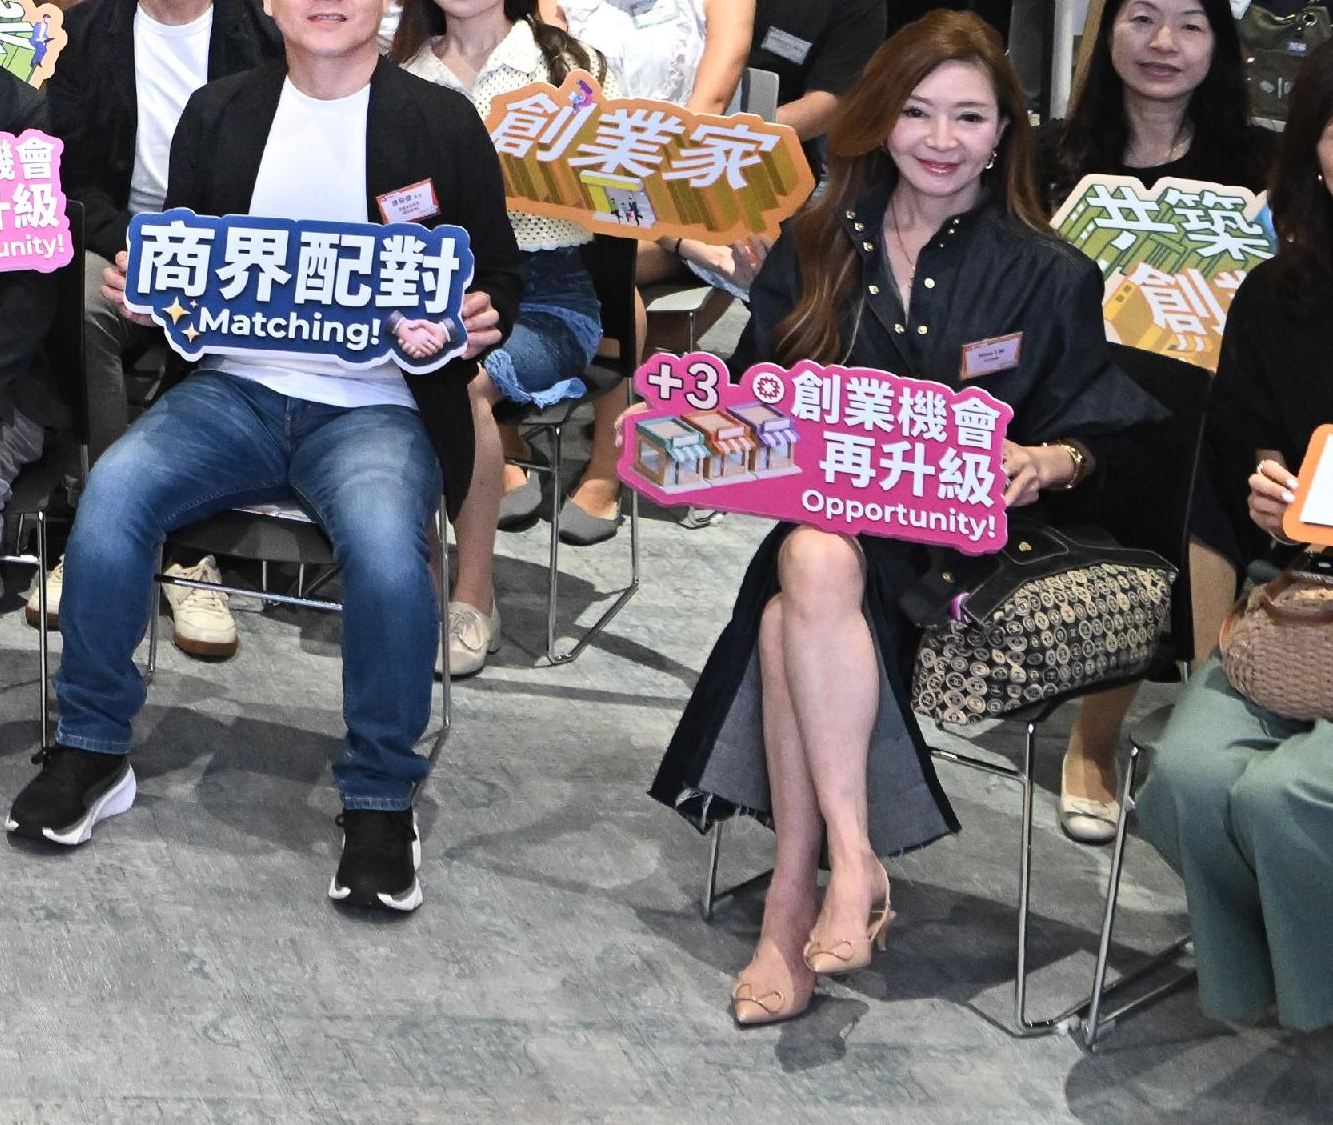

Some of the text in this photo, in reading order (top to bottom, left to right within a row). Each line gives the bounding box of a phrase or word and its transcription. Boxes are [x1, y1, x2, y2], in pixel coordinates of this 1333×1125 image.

[490, 90, 780, 189] 創業家
[1088, 184, 1274, 260] 共築
[136, 221, 461, 314] 商界配對
[196, 307, 381, 347] Matching!
[647, 361, 720, 410] +3
[791, 370, 1002, 450] 創業機會
[821, 430, 997, 508] 再升級
[801, 487, 996, 541] Opportunity!
